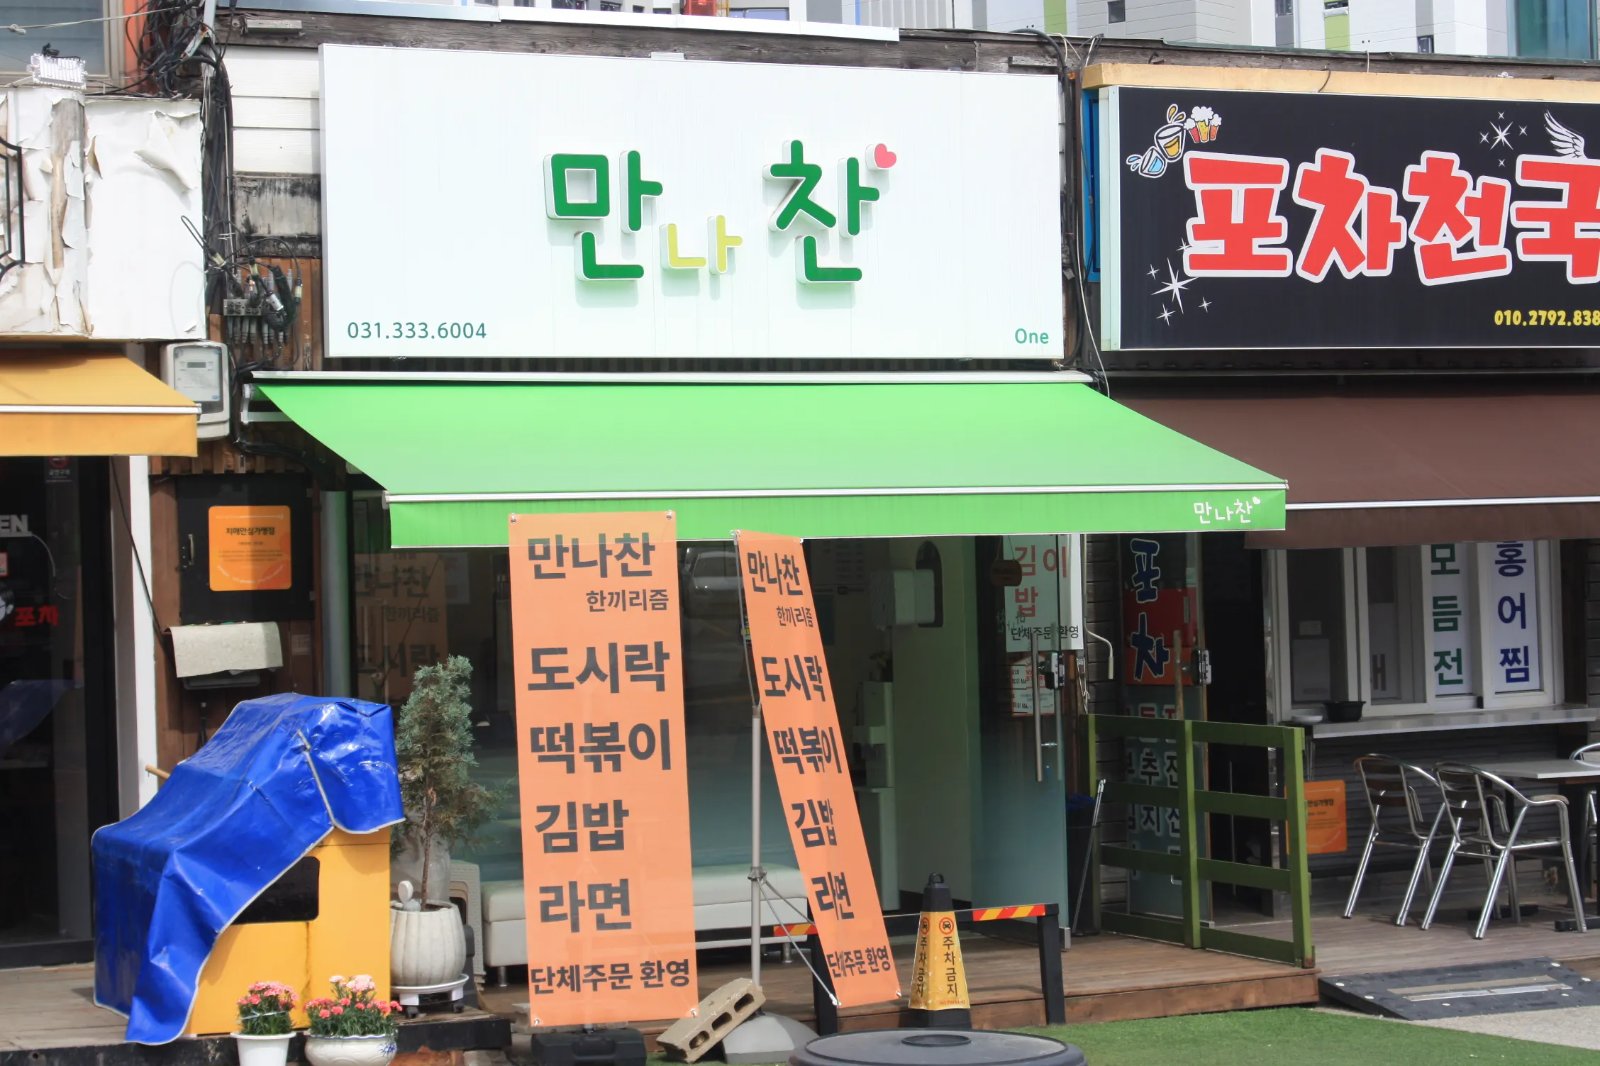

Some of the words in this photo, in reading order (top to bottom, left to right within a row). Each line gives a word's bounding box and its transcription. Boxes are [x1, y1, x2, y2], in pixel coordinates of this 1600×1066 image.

[549, 139, 881, 283] 만나찬
[1183, 147, 1600, 287] 포차천국
[346, 322, 488, 340] 031.333.6004
[1014, 328, 1050, 345] One
[1494, 309, 1600, 327] 010.2792.838
[1193, 498, 1253, 524] 만나찬
[528, 533, 656, 581] 만나찬
[747, 551, 804, 596] 만나찬
[587, 589, 669, 613] 한끼리즘
[776, 605, 815, 628] 한끼리즘
[1131, 538, 1170, 682] 포차
[1430, 543, 1464, 686] 모듬전
[1494, 541, 1531, 684] 홍어찜
[527, 640, 670, 694] 도시락
[761, 653, 827, 703] 도시락
[530, 719, 672, 775] 떡볶이
[773, 726, 844, 776] 떡볶이
[535, 799, 631, 855] 김밥
[792, 797, 838, 849] 김밥
[539, 878, 633, 934] 라면
[811, 870, 856, 922] 라면
[530, 963, 634, 995] 단체주문
[639, 958, 691, 989] 환영
[827, 947, 865, 980] 단체주문
[865, 944, 893, 973] 환영
[915, 936, 929, 998] 주차금지
[943, 936, 959, 997] 주차금지
